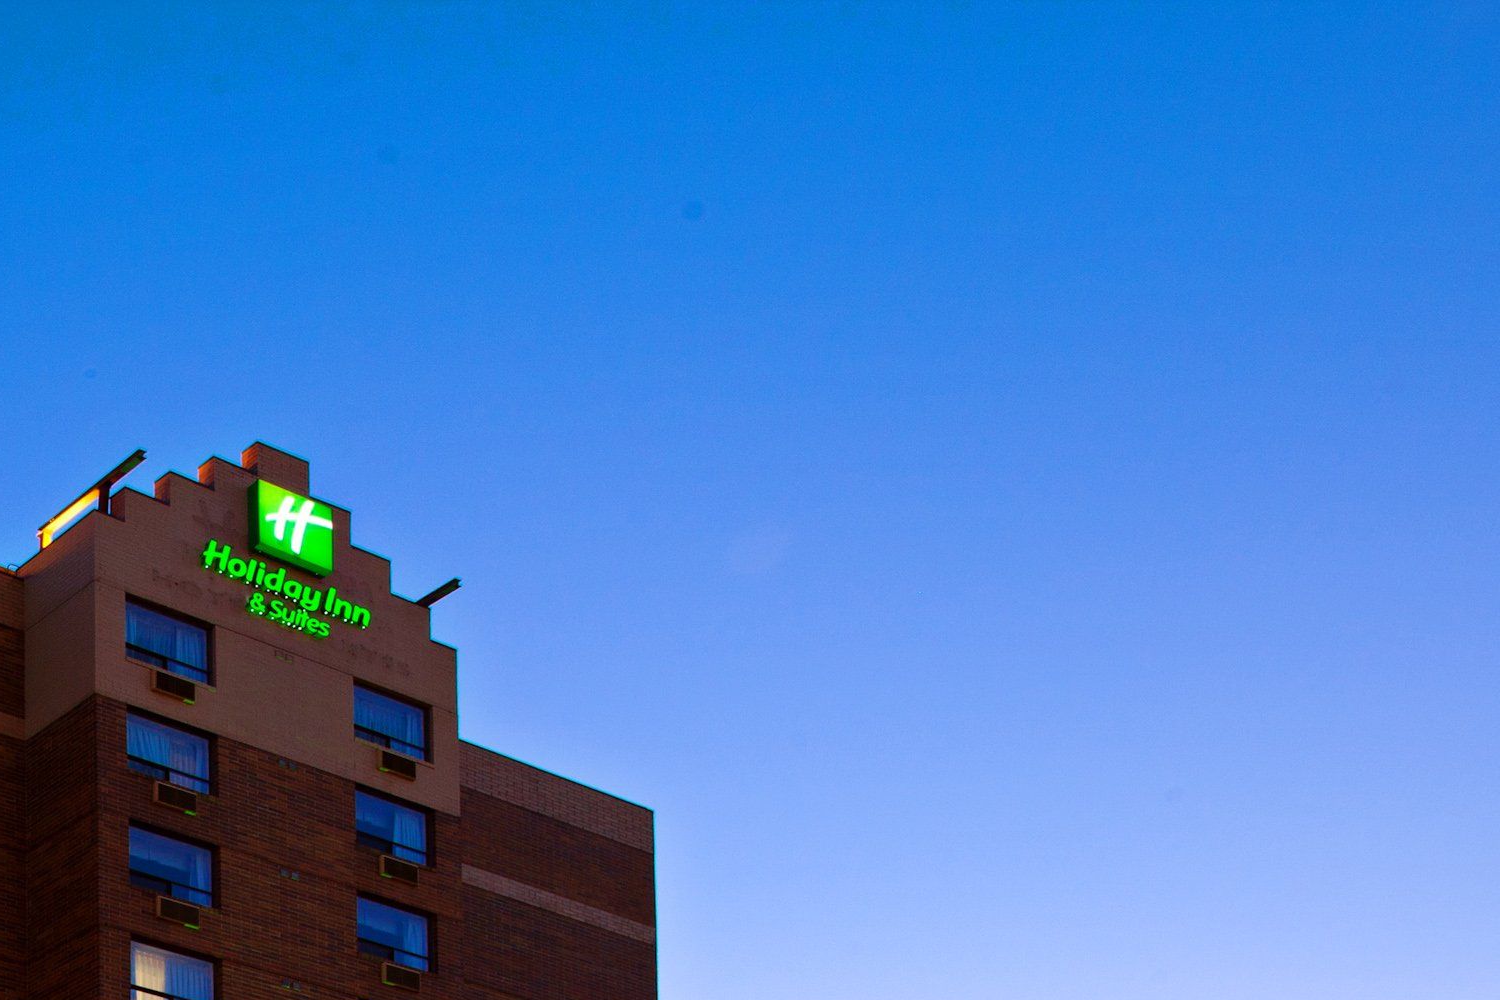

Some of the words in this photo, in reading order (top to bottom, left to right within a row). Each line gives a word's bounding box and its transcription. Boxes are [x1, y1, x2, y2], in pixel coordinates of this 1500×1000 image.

[203, 540, 322, 612] Holiday
[325, 587, 371, 627] Inn
[249, 592, 266, 614] &
[268, 599, 330, 637] Suites
